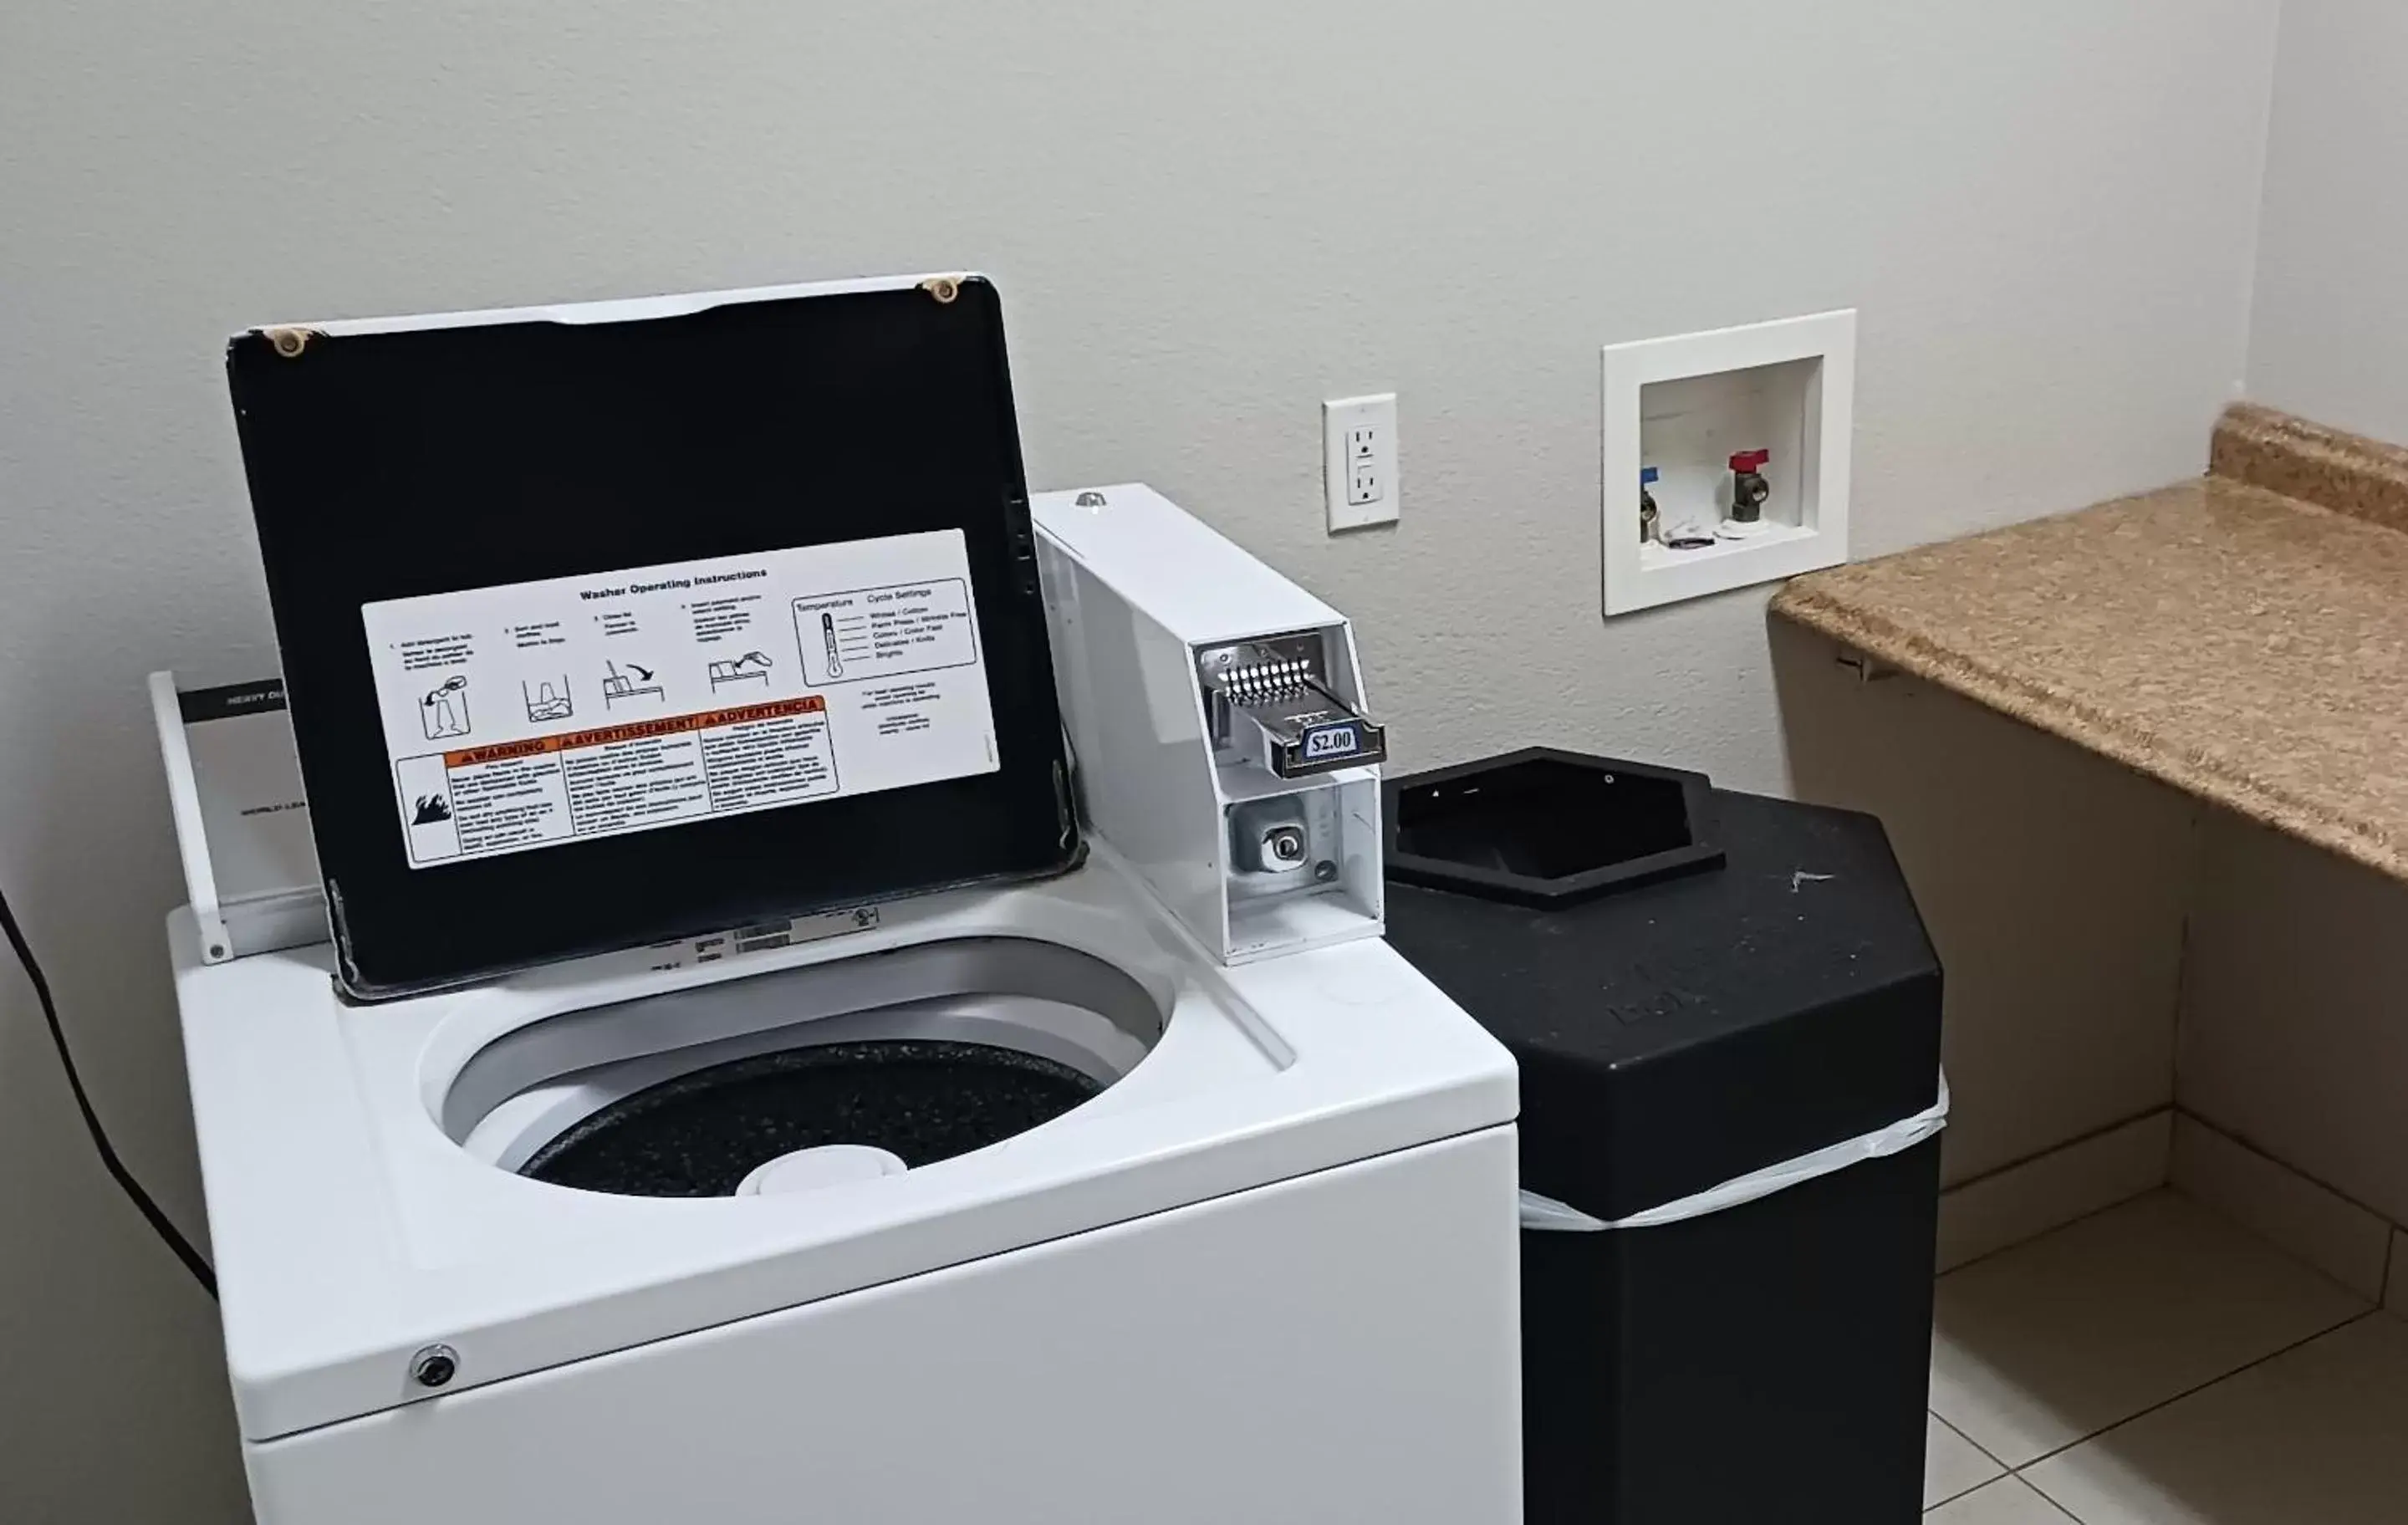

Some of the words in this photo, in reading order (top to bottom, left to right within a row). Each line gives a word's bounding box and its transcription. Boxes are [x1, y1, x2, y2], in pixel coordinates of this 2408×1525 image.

[580, 587, 625, 600] Washer
[630, 579, 691, 594] Operating
[695, 569, 768, 585] Instructions
[796, 599, 853, 612] Temperature
[867, 594, 893, 603] Cycle
[895, 589, 931, 599] Settings
[473, 741, 545, 759] WARNING
[573, 717, 693, 744] AVERTISSEMENT
[718, 699, 818, 722] ADVERTENCIA
[1312, 732, 1351, 752] $2.00
